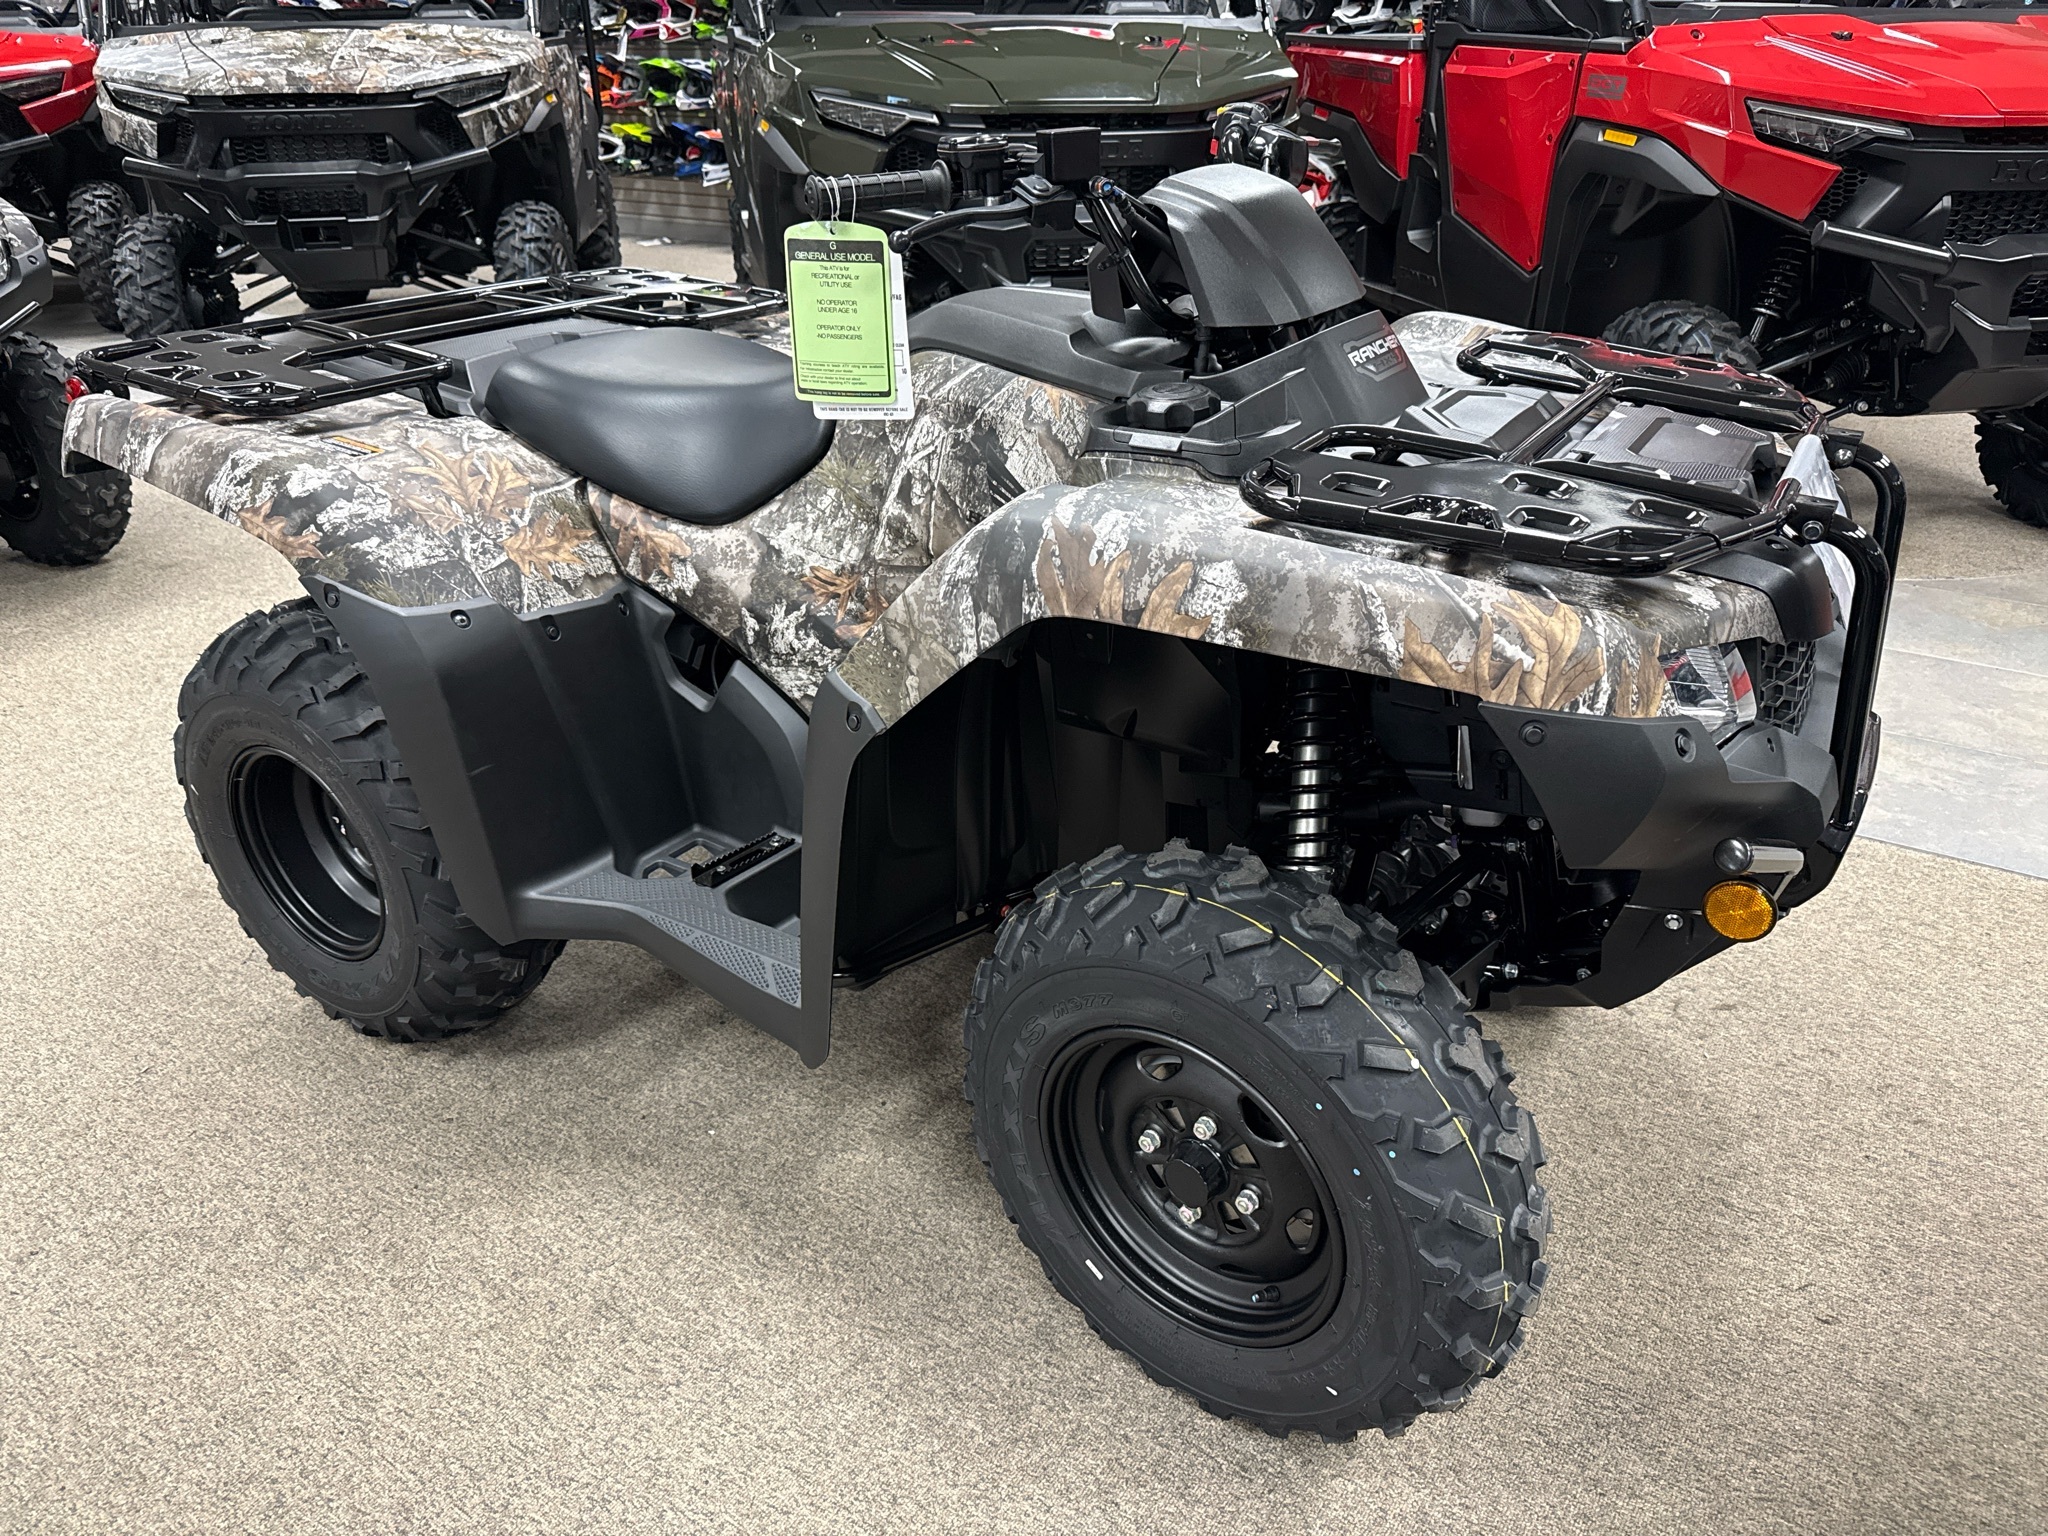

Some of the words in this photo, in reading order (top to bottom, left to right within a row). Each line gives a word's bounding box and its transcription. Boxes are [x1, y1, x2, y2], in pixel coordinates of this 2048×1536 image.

[829, 241, 837, 250] G
[794, 250, 829, 261] GENERAL
[830, 252, 846, 261] USE
[847, 253, 876, 262] MODEL
[811, 272, 853, 280] RECREATIONAL
[1051, 992, 1114, 1020] M977
[1001, 1012, 1069, 1249] MAXXIS
